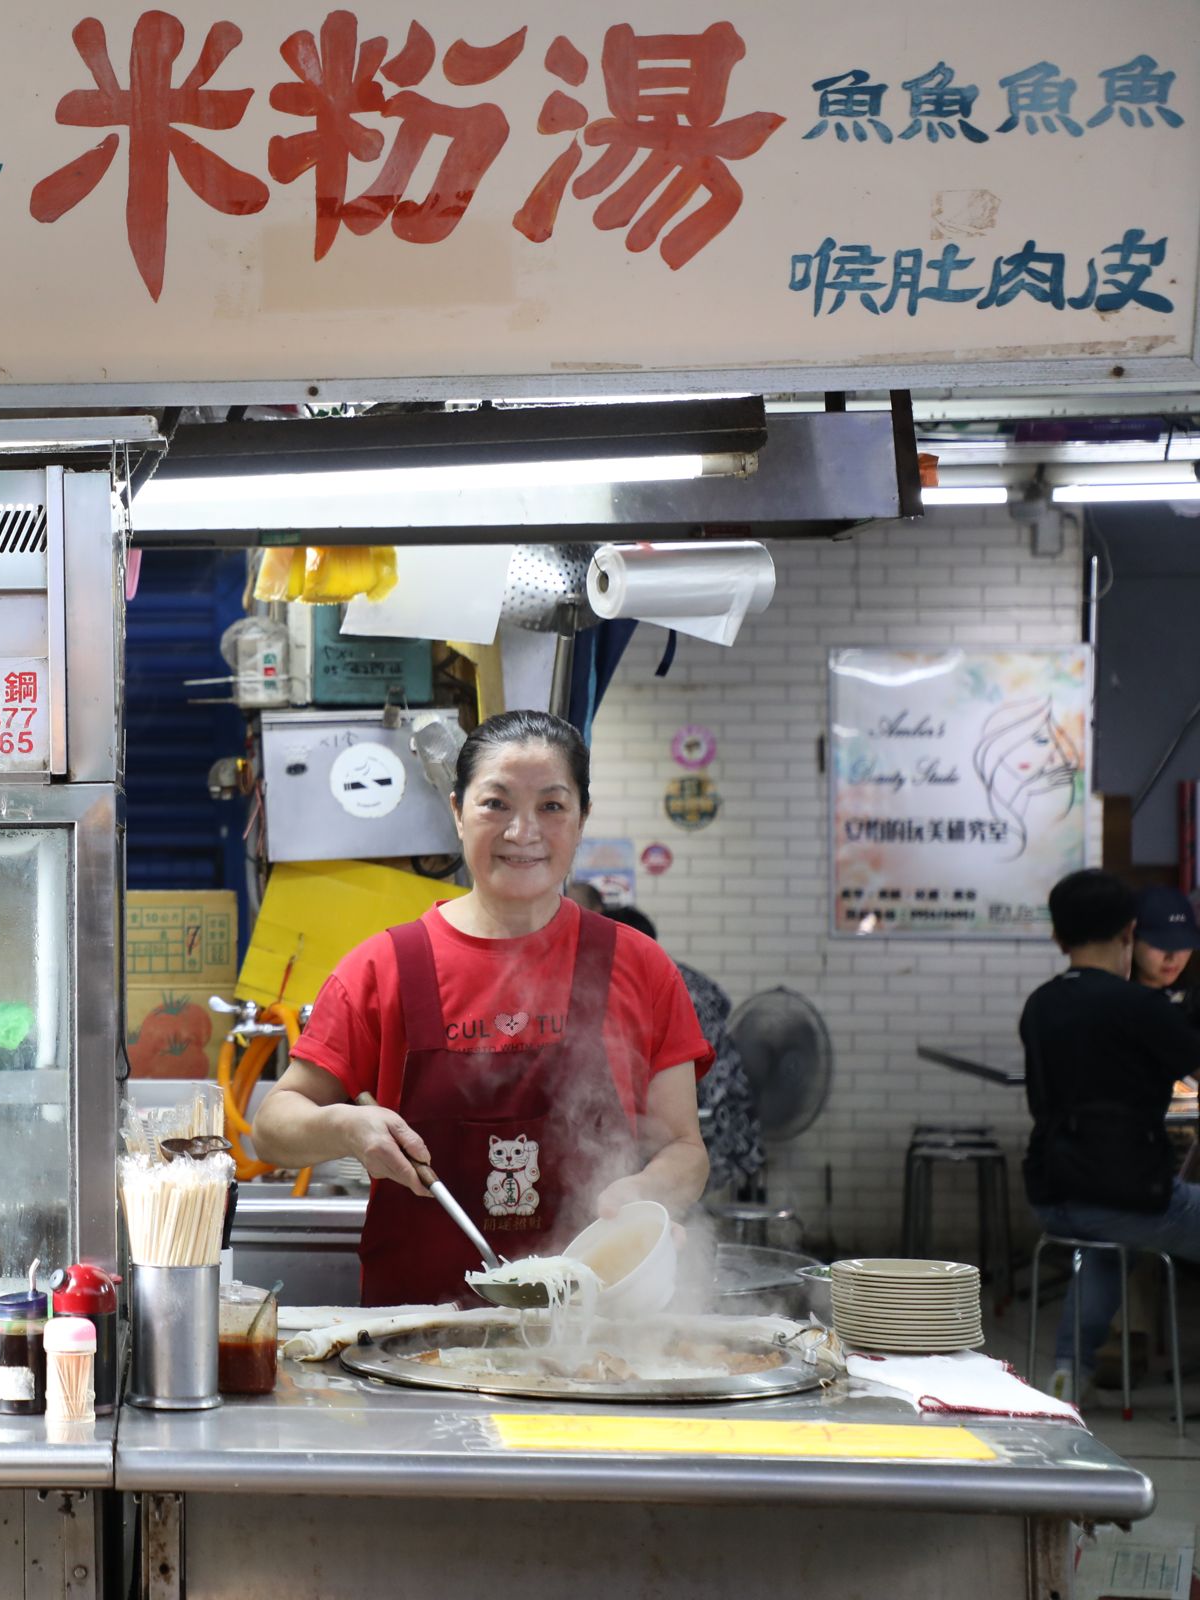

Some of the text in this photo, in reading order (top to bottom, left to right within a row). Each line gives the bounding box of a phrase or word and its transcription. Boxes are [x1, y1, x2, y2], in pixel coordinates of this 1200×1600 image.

[29, 9, 786, 303] 米粉湯
[445, 1019, 490, 1040] CUL
